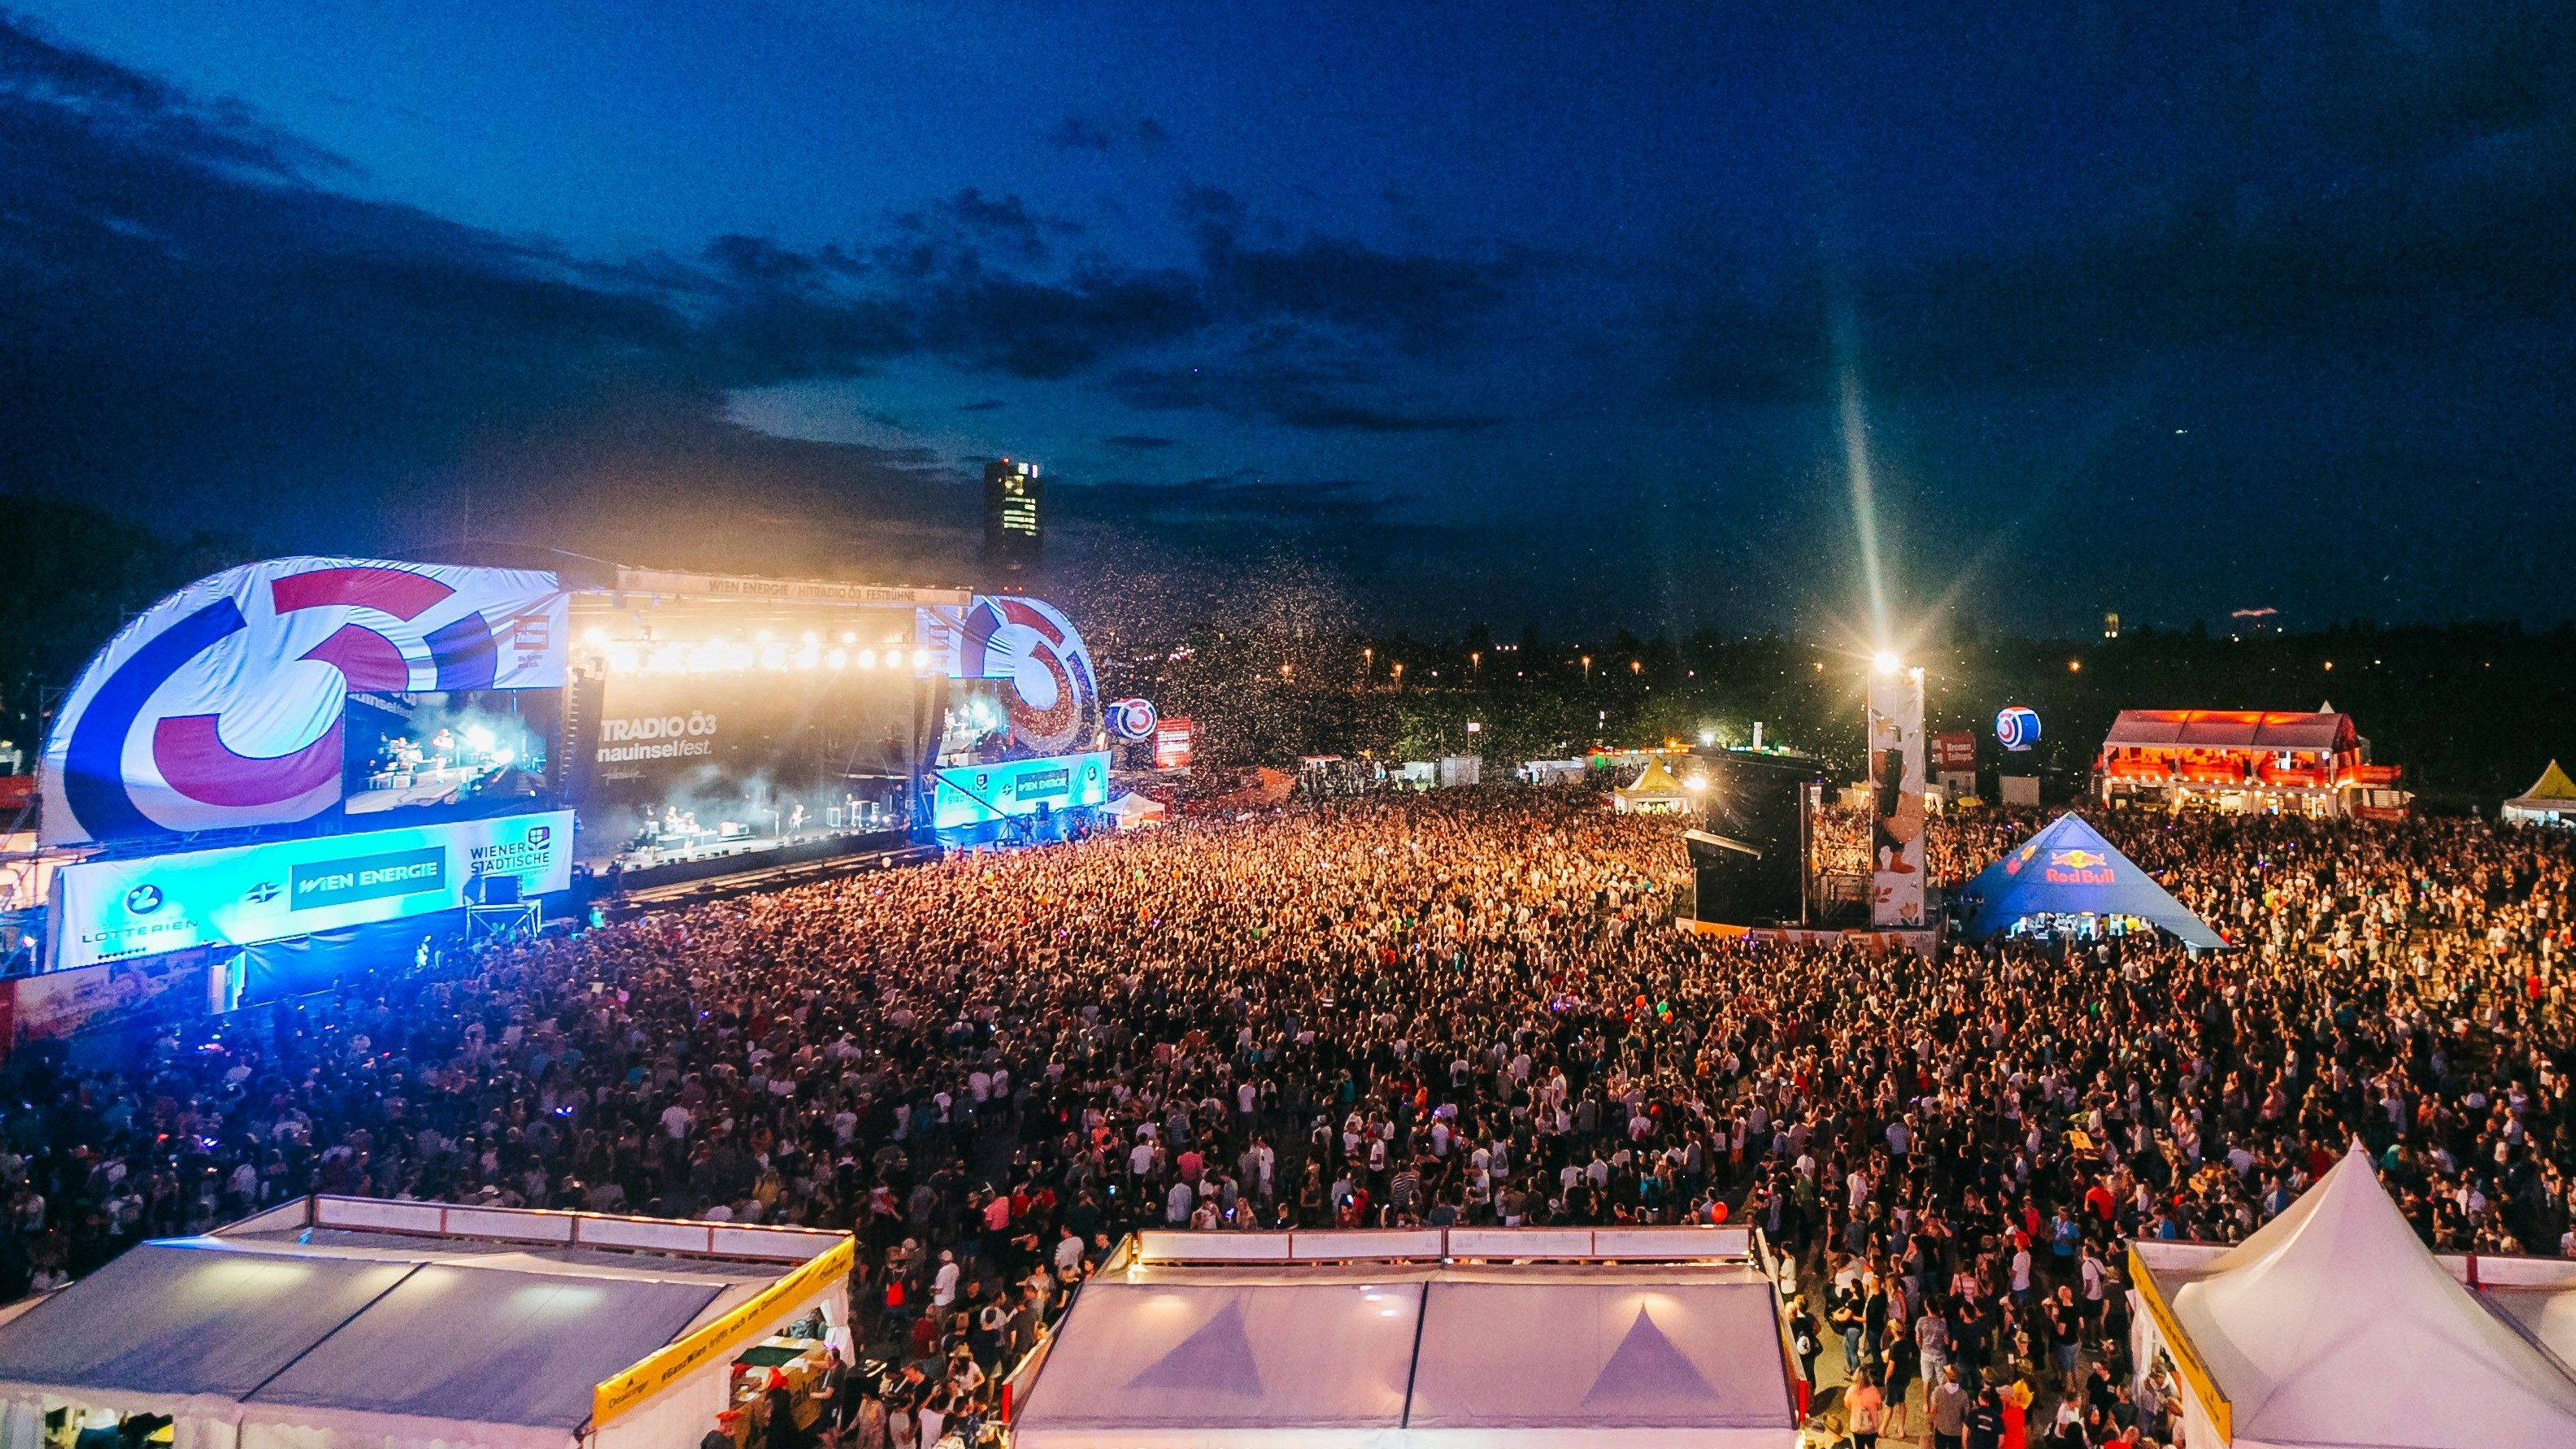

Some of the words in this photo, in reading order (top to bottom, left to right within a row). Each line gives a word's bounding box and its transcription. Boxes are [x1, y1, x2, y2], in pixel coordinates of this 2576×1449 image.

[709, 580, 739, 593] WIEN
[742, 582, 789, 595] ENERGIE
[688, 710, 716, 736] Ö3
[471, 842, 525, 859] WIENER
[471, 851, 550, 874] STÄDTISCHE
[298, 872, 353, 894] WIEN
[359, 862, 437, 886] ENERGIE
[2045, 868, 2080, 882] Red
[2081, 868, 2114, 883] Bull
[81, 919, 198, 943] LOTTERIEN
